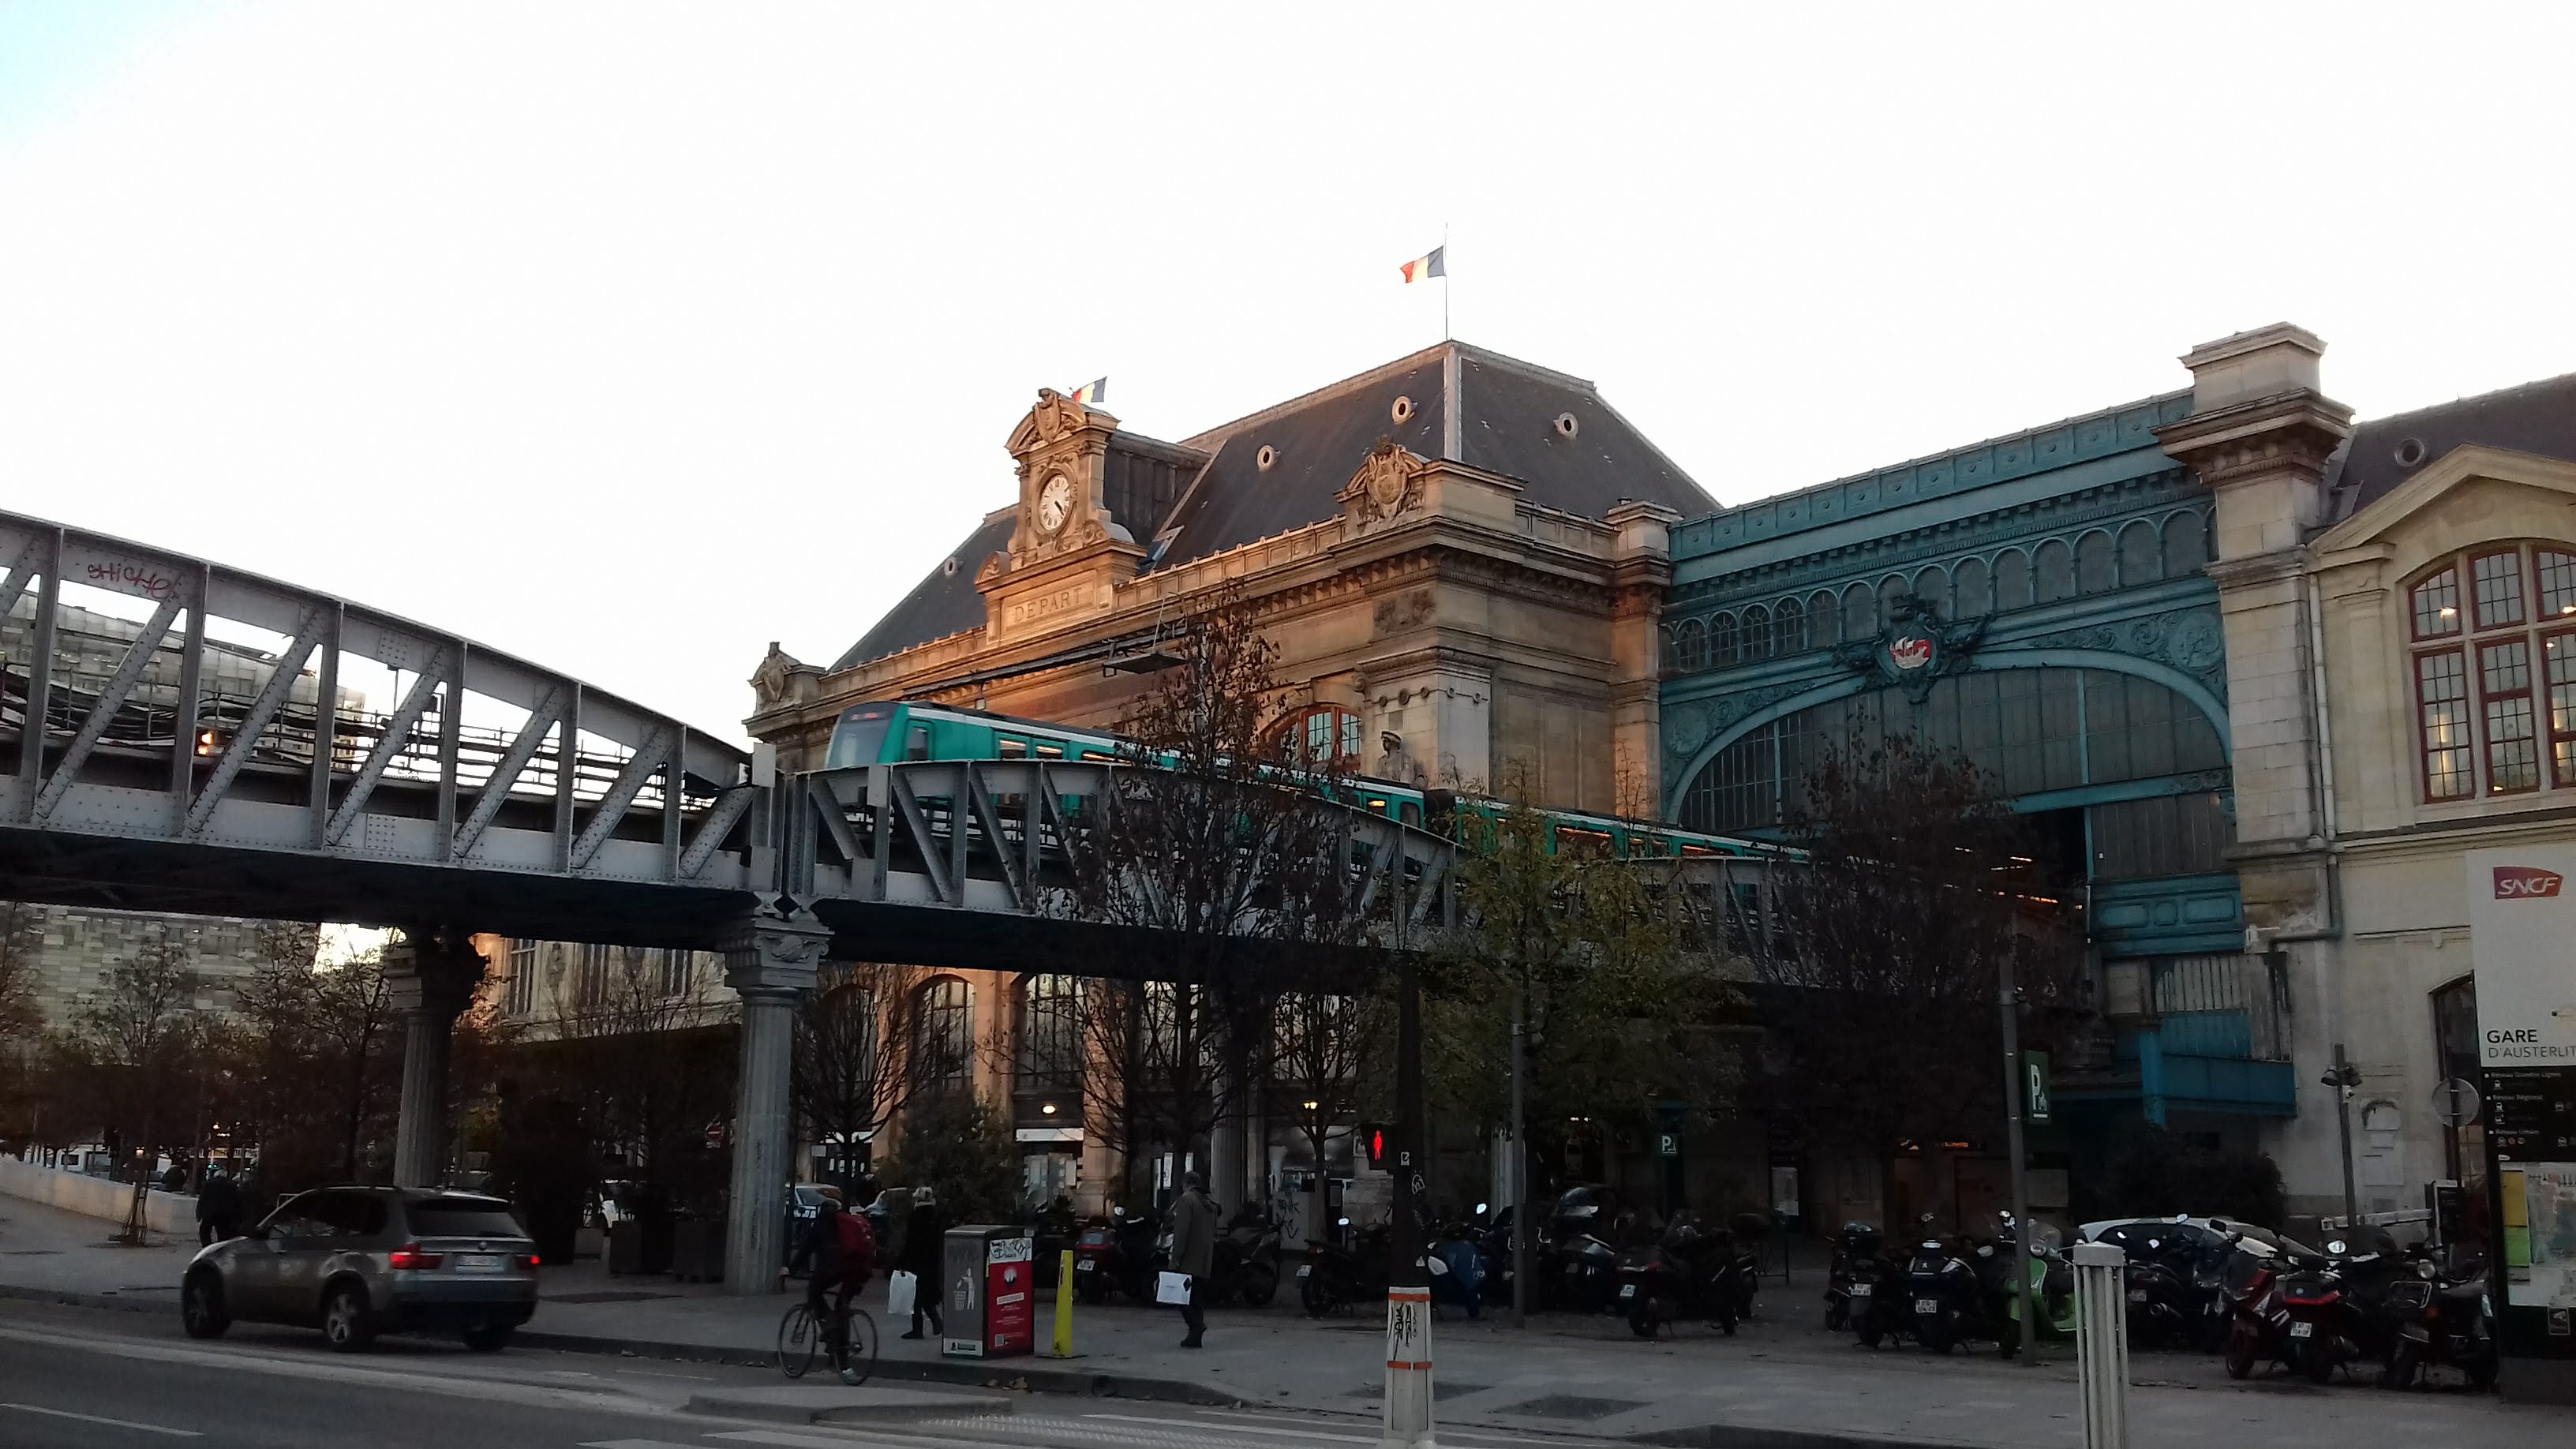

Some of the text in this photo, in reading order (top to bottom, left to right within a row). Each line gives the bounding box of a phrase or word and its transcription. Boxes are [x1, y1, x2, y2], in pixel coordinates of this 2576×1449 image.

[2497, 877, 2558, 895] SNCF
[2487, 1029, 2538, 1043] GARE
[2488, 1046, 2576, 1058] D'AUSTERLIT
[2031, 1063, 2041, 1110] P
[1661, 1135, 1672, 1151] P
